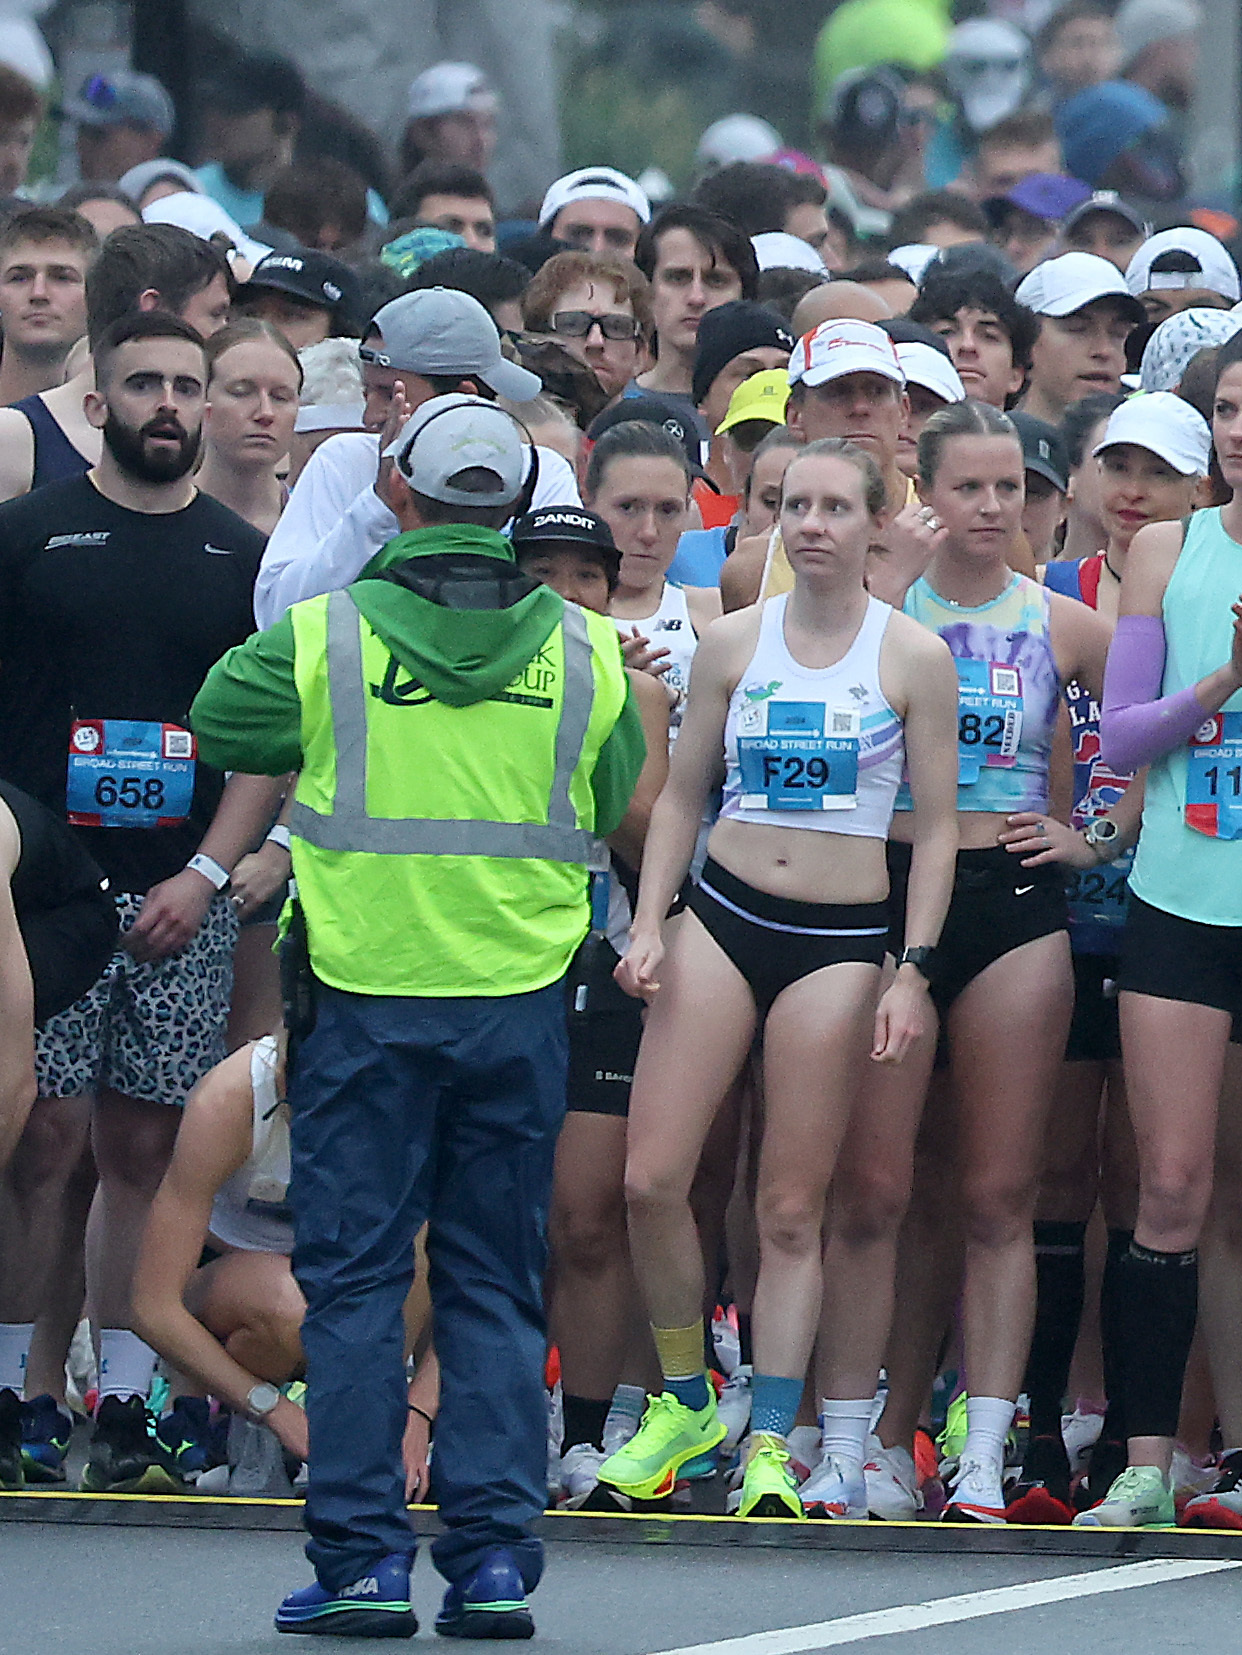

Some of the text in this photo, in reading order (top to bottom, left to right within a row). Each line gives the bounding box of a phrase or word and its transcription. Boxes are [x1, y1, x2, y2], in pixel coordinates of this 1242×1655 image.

[991, 698, 1017, 709] RUN
[740, 739, 779, 750] BROAD
[780, 740, 823, 751] STREET
[825, 740, 854, 751] RUN
[1193, 749, 1234, 759] BROAD
[762, 755, 829, 789] F29
[95, 775, 165, 810] 658
